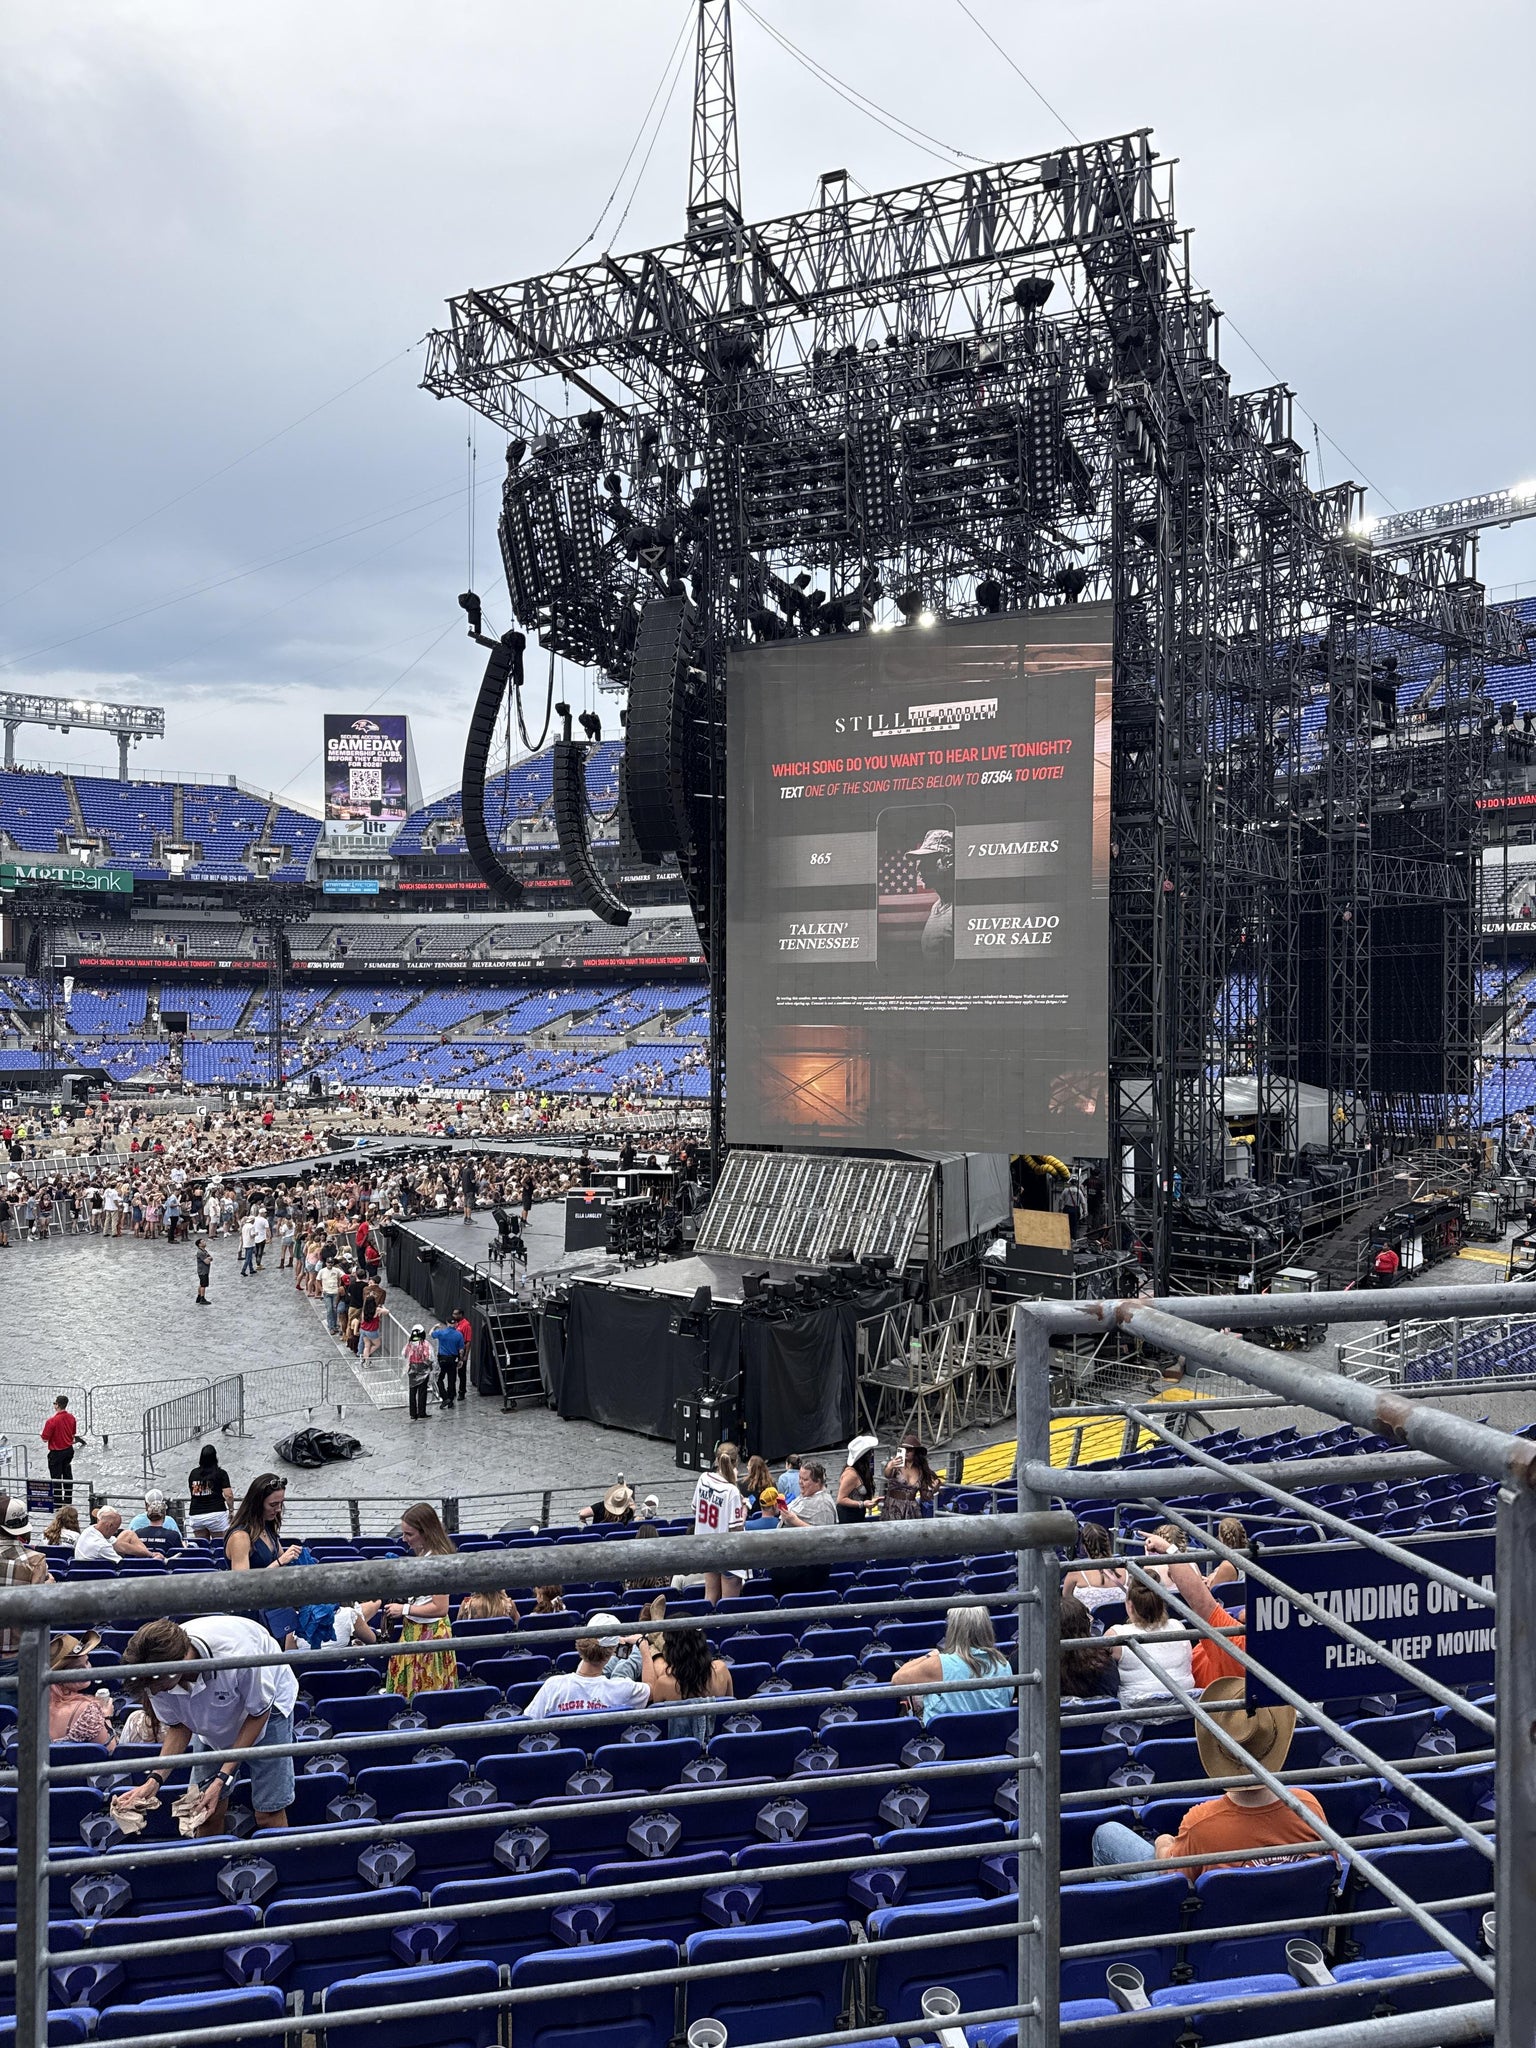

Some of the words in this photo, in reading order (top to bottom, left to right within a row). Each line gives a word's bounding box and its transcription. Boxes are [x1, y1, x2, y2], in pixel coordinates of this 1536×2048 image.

[835, 712, 905, 733] STILL
[910, 710, 932, 726] THE
[937, 703, 997, 725] PROBLEM
[328, 739, 403, 751] GAMEDAY
[772, 760, 810, 777] WHICH
[812, 758, 843, 775] SONG
[846, 757, 862, 772] DO
[864, 755, 888, 771] YOU
[890, 752, 925, 769] WANT
[927, 751, 943, 767] TO
[946, 748, 979, 765] HEAR
[981, 746, 1007, 762] LIVE
[1009, 739, 1073, 760] TONIGHT?
[780, 786, 804, 799] TEXT
[804, 784, 825, 797] ONE
[827, 783, 840, 796] OF
[842, 781, 860, 795] THE
[862, 780, 890, 793] SONG
[892, 777, 924, 791] TITLES
[926, 774, 964, 789] BELOW
[965, 773, 980, 786] TO
[981, 769, 1013, 785] 87364
[1015, 768, 1030, 782] TO
[1032, 765, 1065, 780] VOTE!
[1488, 798, 1499, 808] DO
[363, 819, 387, 836] Lite
[967, 844, 976, 857] 7
[978, 840, 1059, 857] SUMMERS
[810, 853, 832, 865] 865
[71, 870, 121, 890] Bank
[789, 922, 849, 936] TALKIN'
[967, 915, 1060, 931] SILVERADO
[1481, 922, 1536, 933] SUMMERS
[778, 937, 860, 951] TENNESSEE
[974, 933, 1004, 946] FOR
[1006, 931, 1052, 946] SALE
[598, 958, 609, 966] SONG
[666, 956, 688, 964] TONIGHT?
[698, 1499, 720, 1530] 98
[1256, 1596, 1289, 1632] NO
[1427, 1579, 1459, 1615] ON
[1392, 1635, 1432, 1662] KEEP
